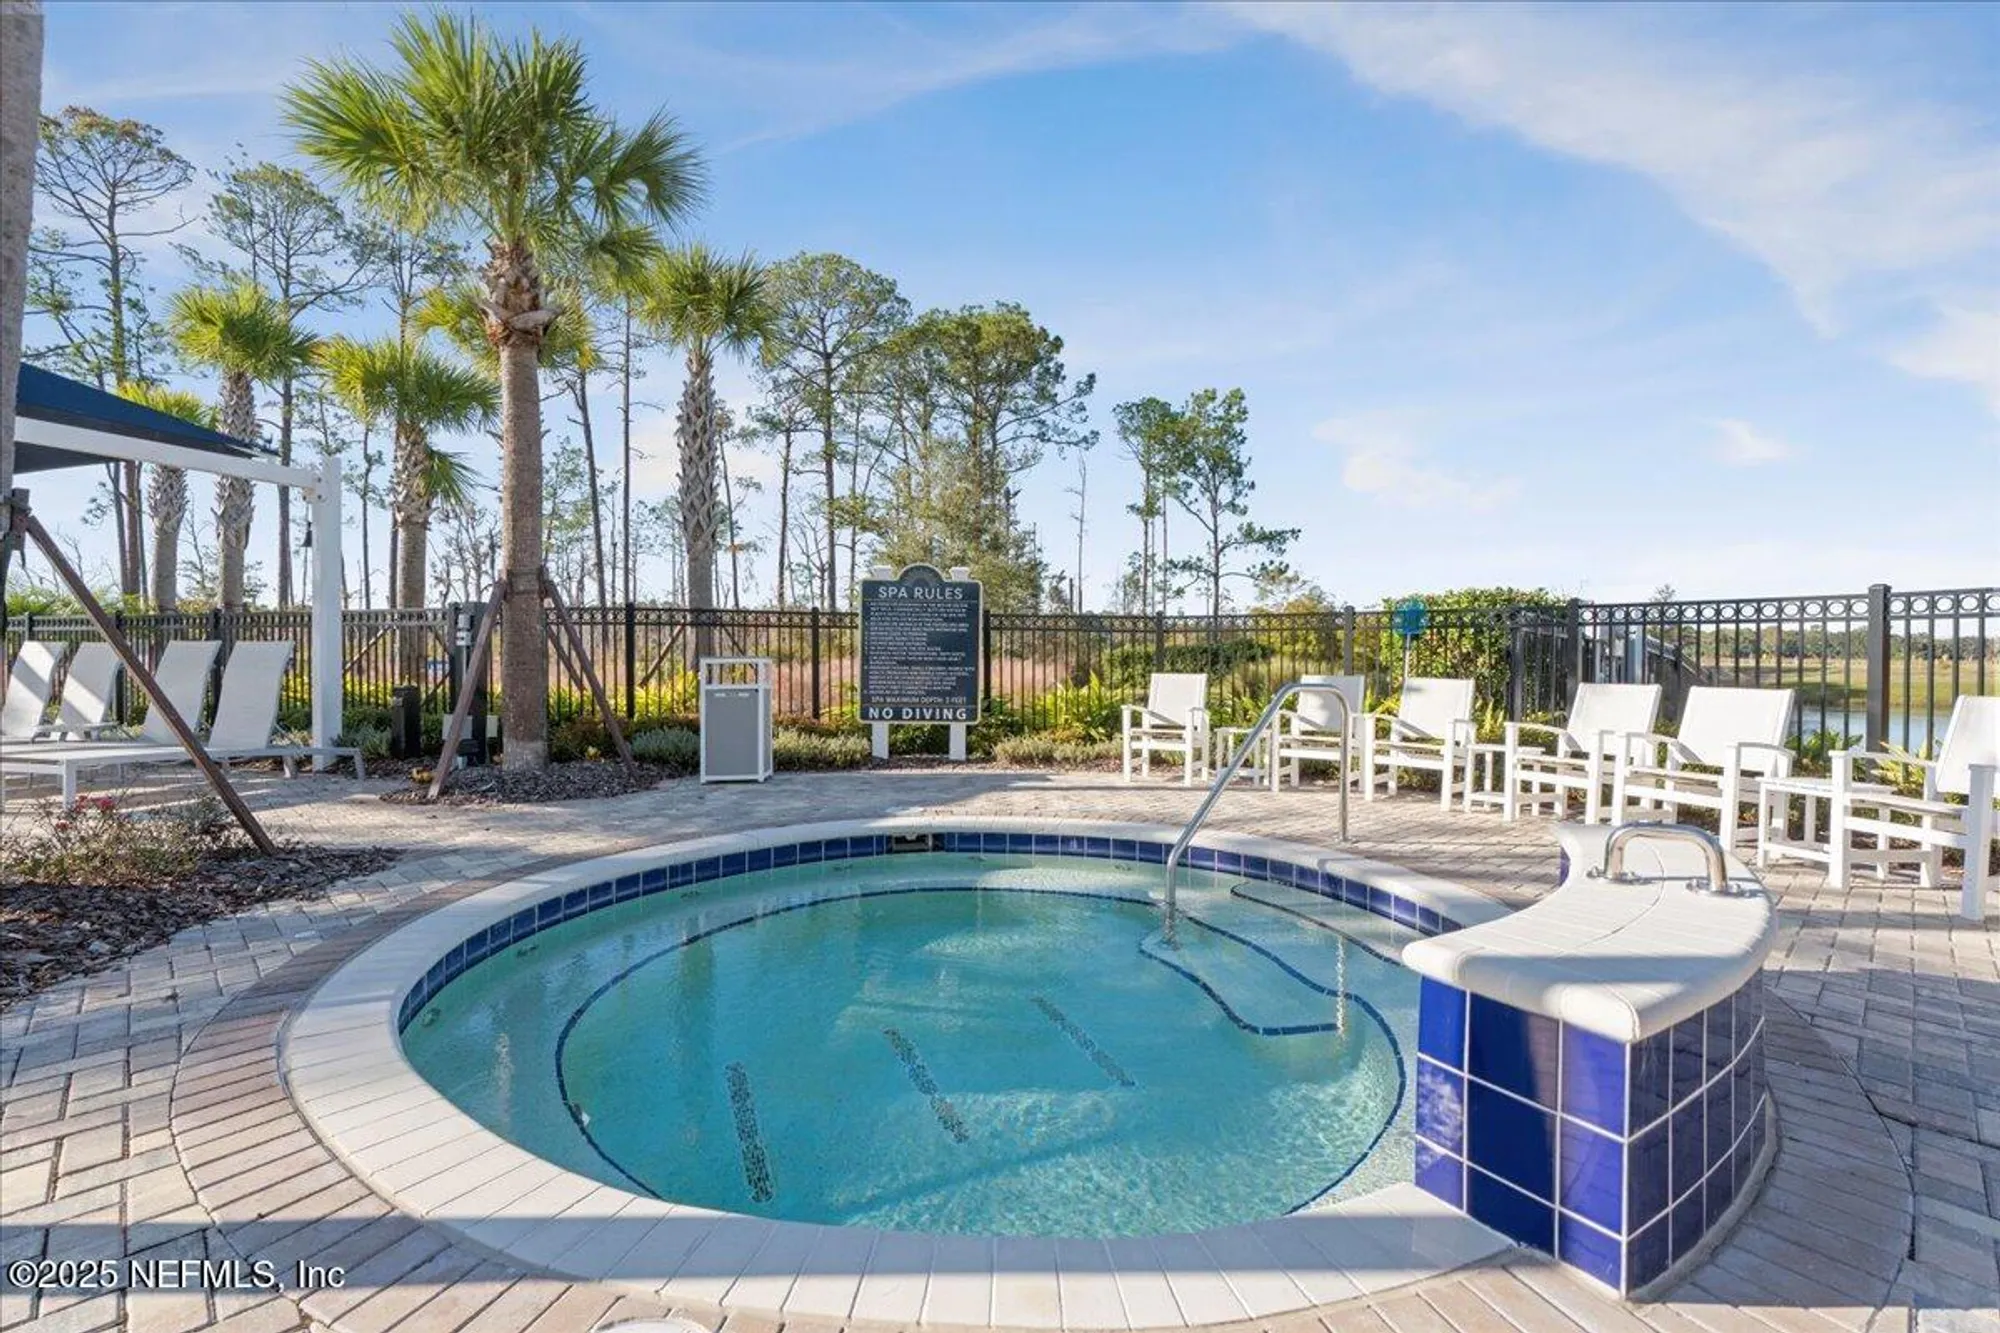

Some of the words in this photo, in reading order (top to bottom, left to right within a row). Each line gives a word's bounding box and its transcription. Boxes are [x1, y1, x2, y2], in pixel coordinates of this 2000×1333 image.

[878, 586, 908, 599] SPA
[913, 587, 963, 600] RULES
[868, 707, 893, 719] NO
[902, 708, 967, 720] DIVING
